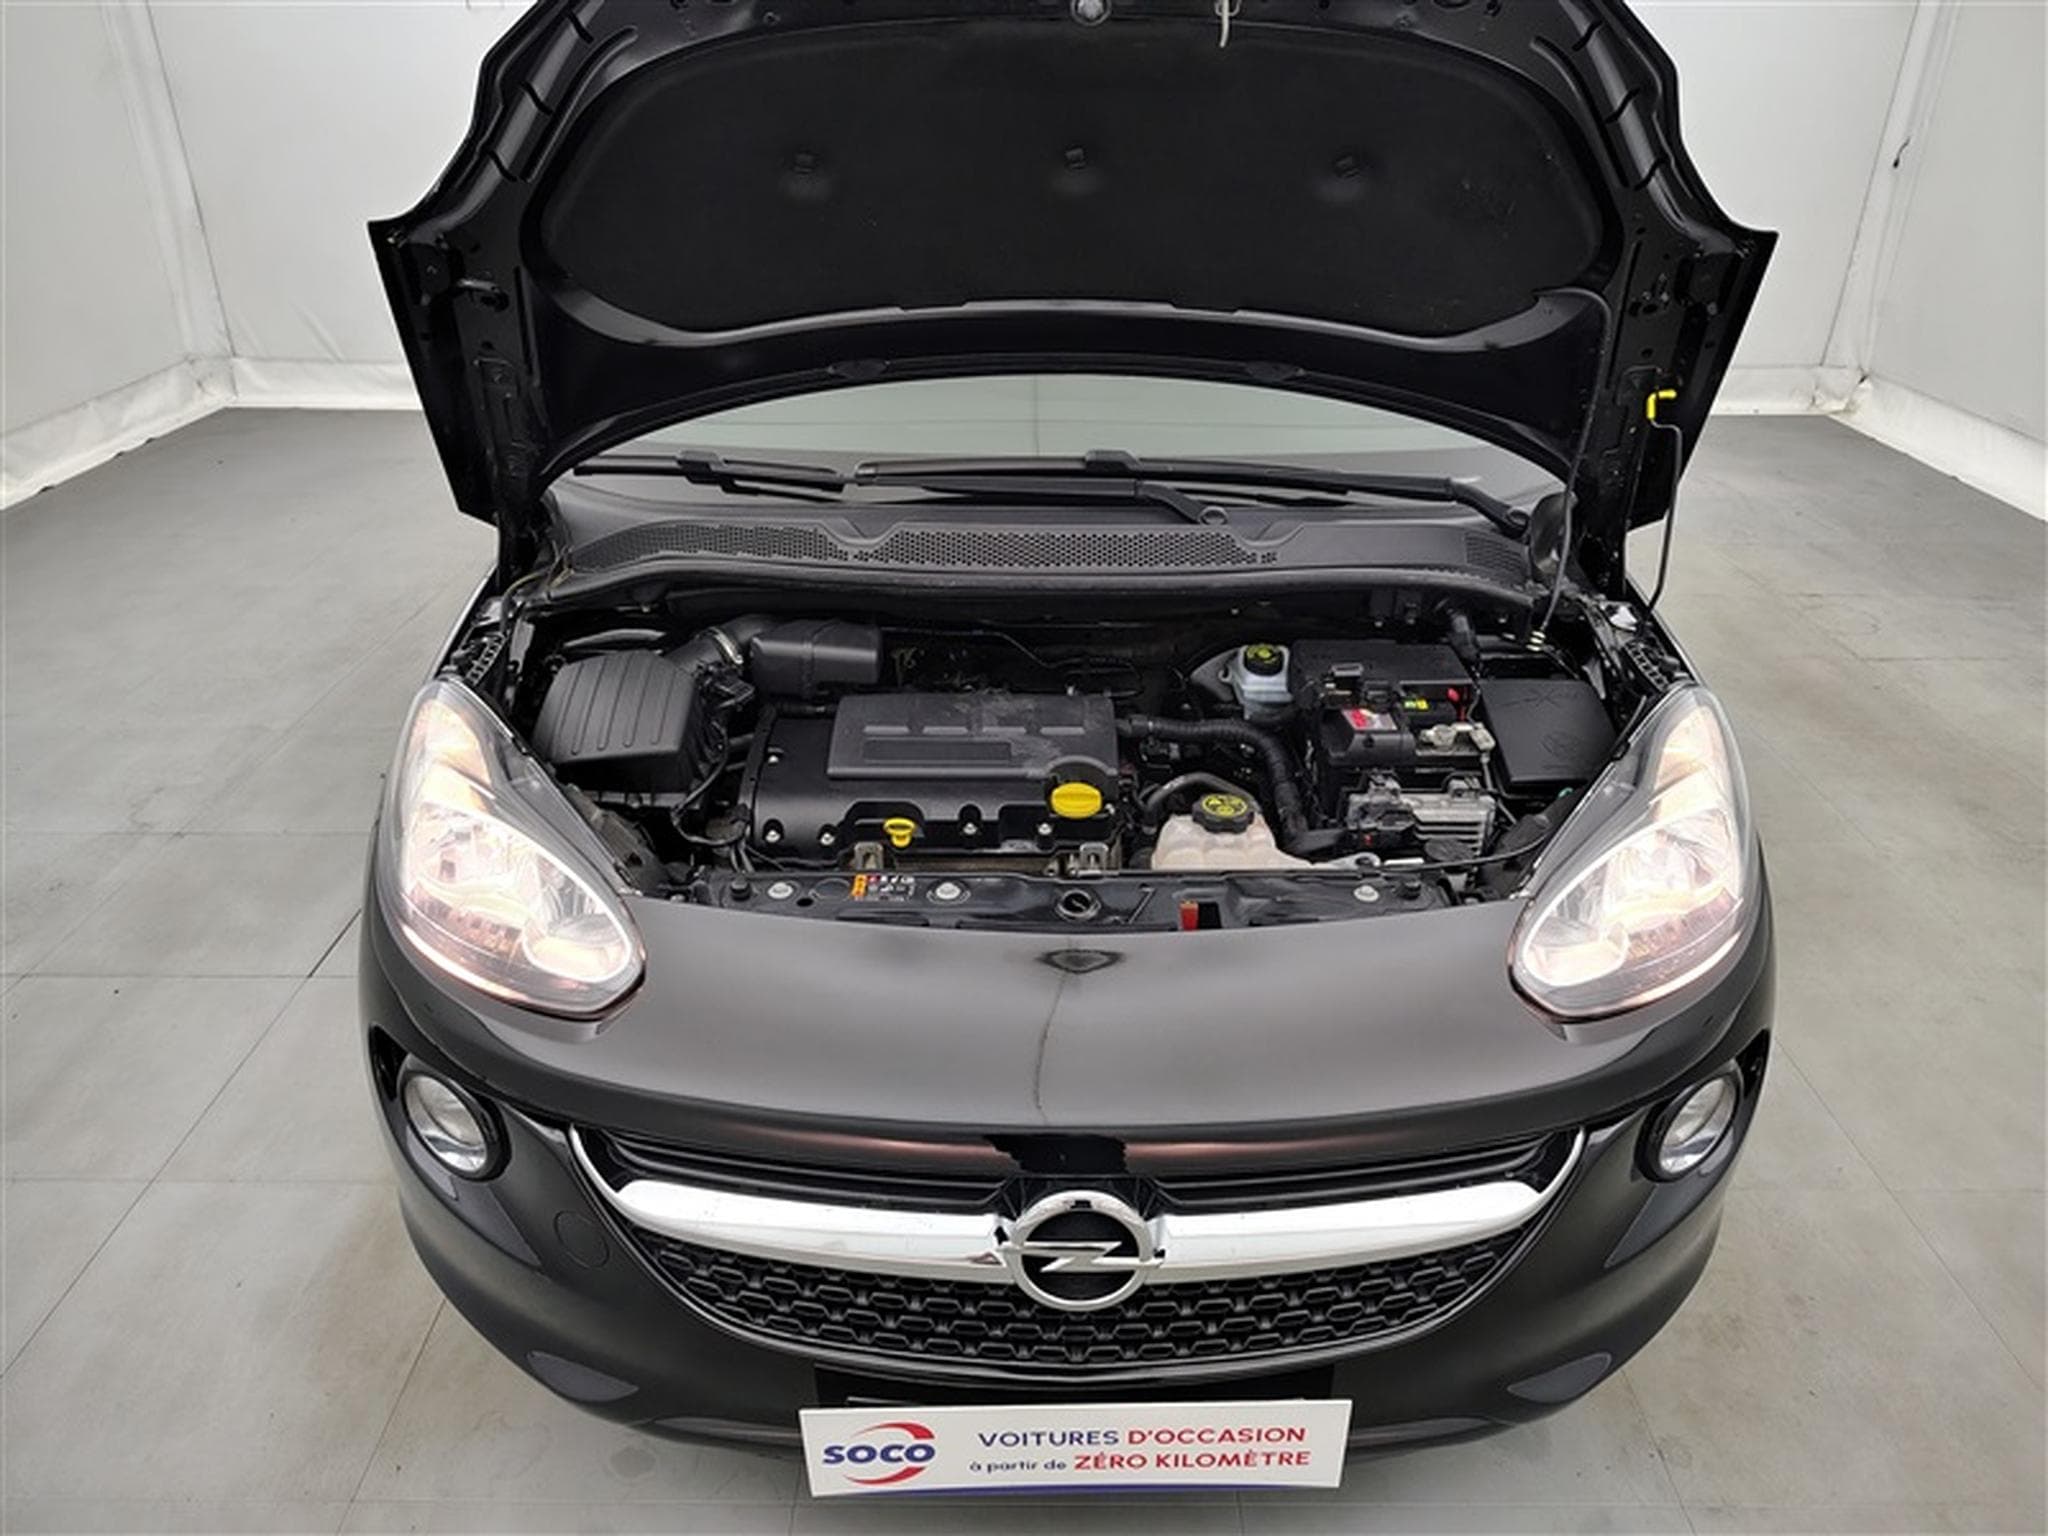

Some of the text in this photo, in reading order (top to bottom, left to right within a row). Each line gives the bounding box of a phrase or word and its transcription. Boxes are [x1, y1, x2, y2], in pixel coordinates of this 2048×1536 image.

[978, 1427, 1306, 1447] VOITURES D'OCCASION
[822, 1444, 935, 1464] SOCO
[986, 1459, 1038, 1474] partir
[1043, 1458, 1067, 1471] de
[1073, 1451, 1148, 1471] ZÉRO
[1155, 1449, 1312, 1469] KILOMÈTRE
